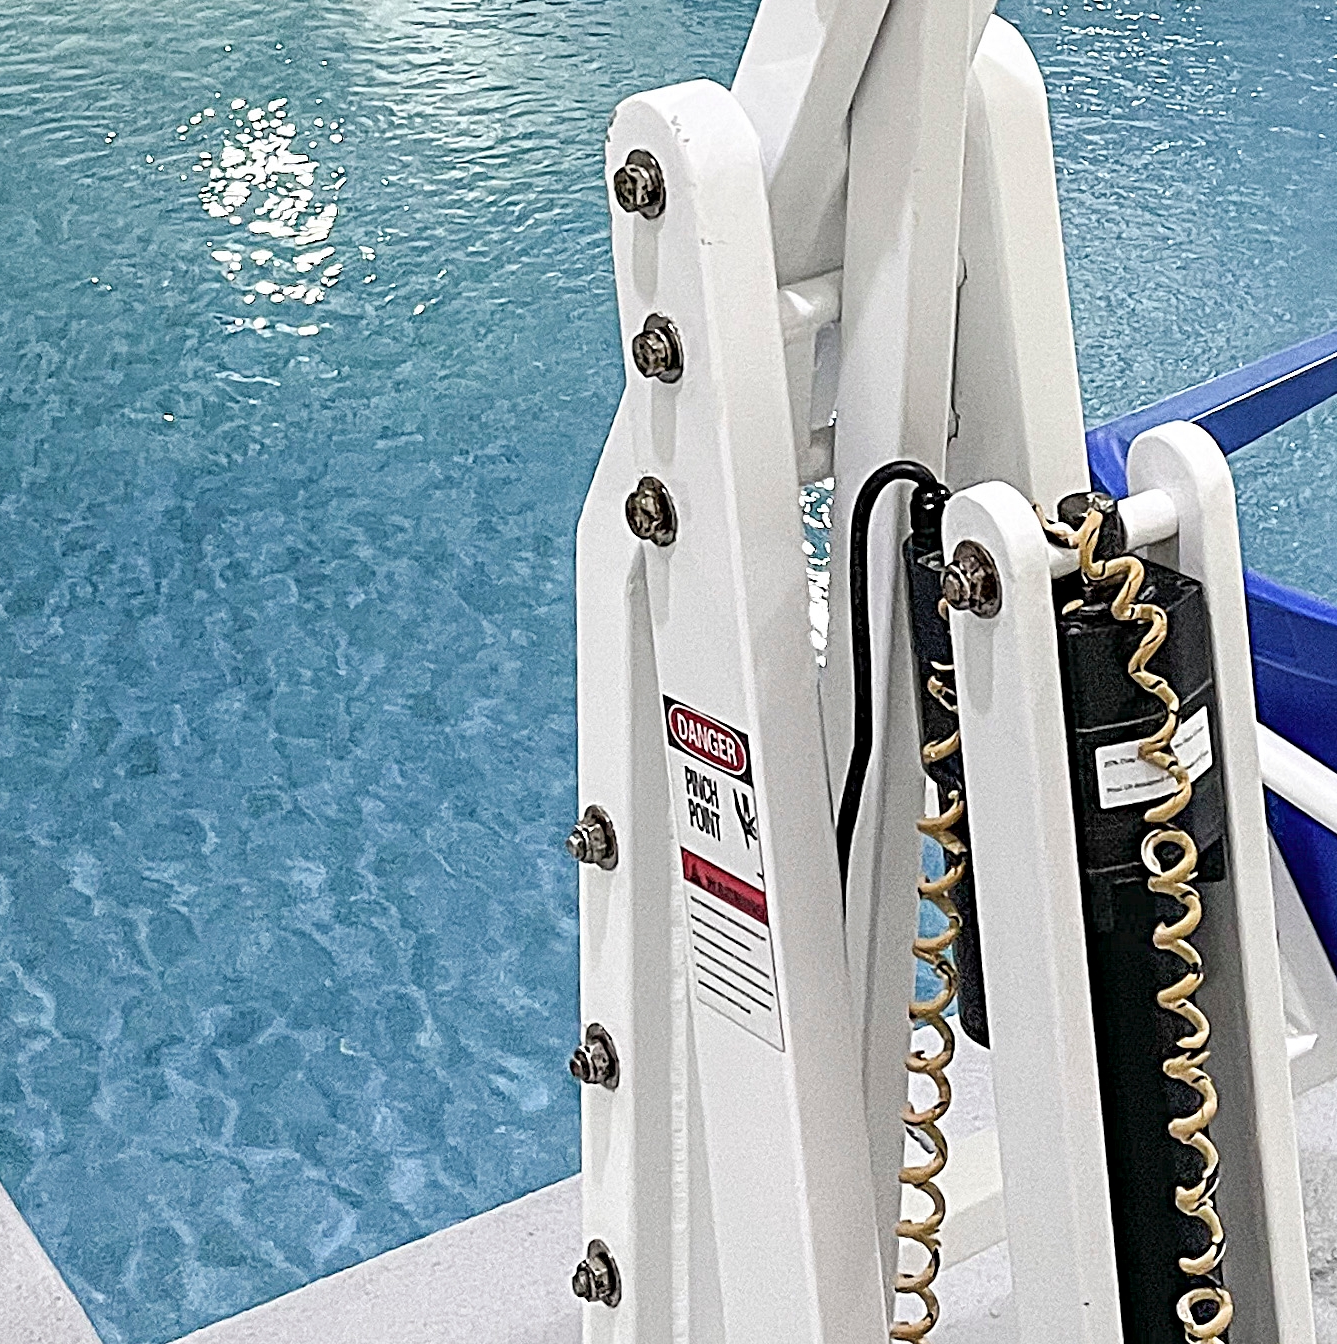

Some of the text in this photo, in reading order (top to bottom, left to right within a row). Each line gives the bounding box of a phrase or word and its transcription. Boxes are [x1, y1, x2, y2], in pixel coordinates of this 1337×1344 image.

[676, 712, 738, 767] DANGER
[684, 765, 720, 810] PINCH
[687, 797, 721, 842] POINT
